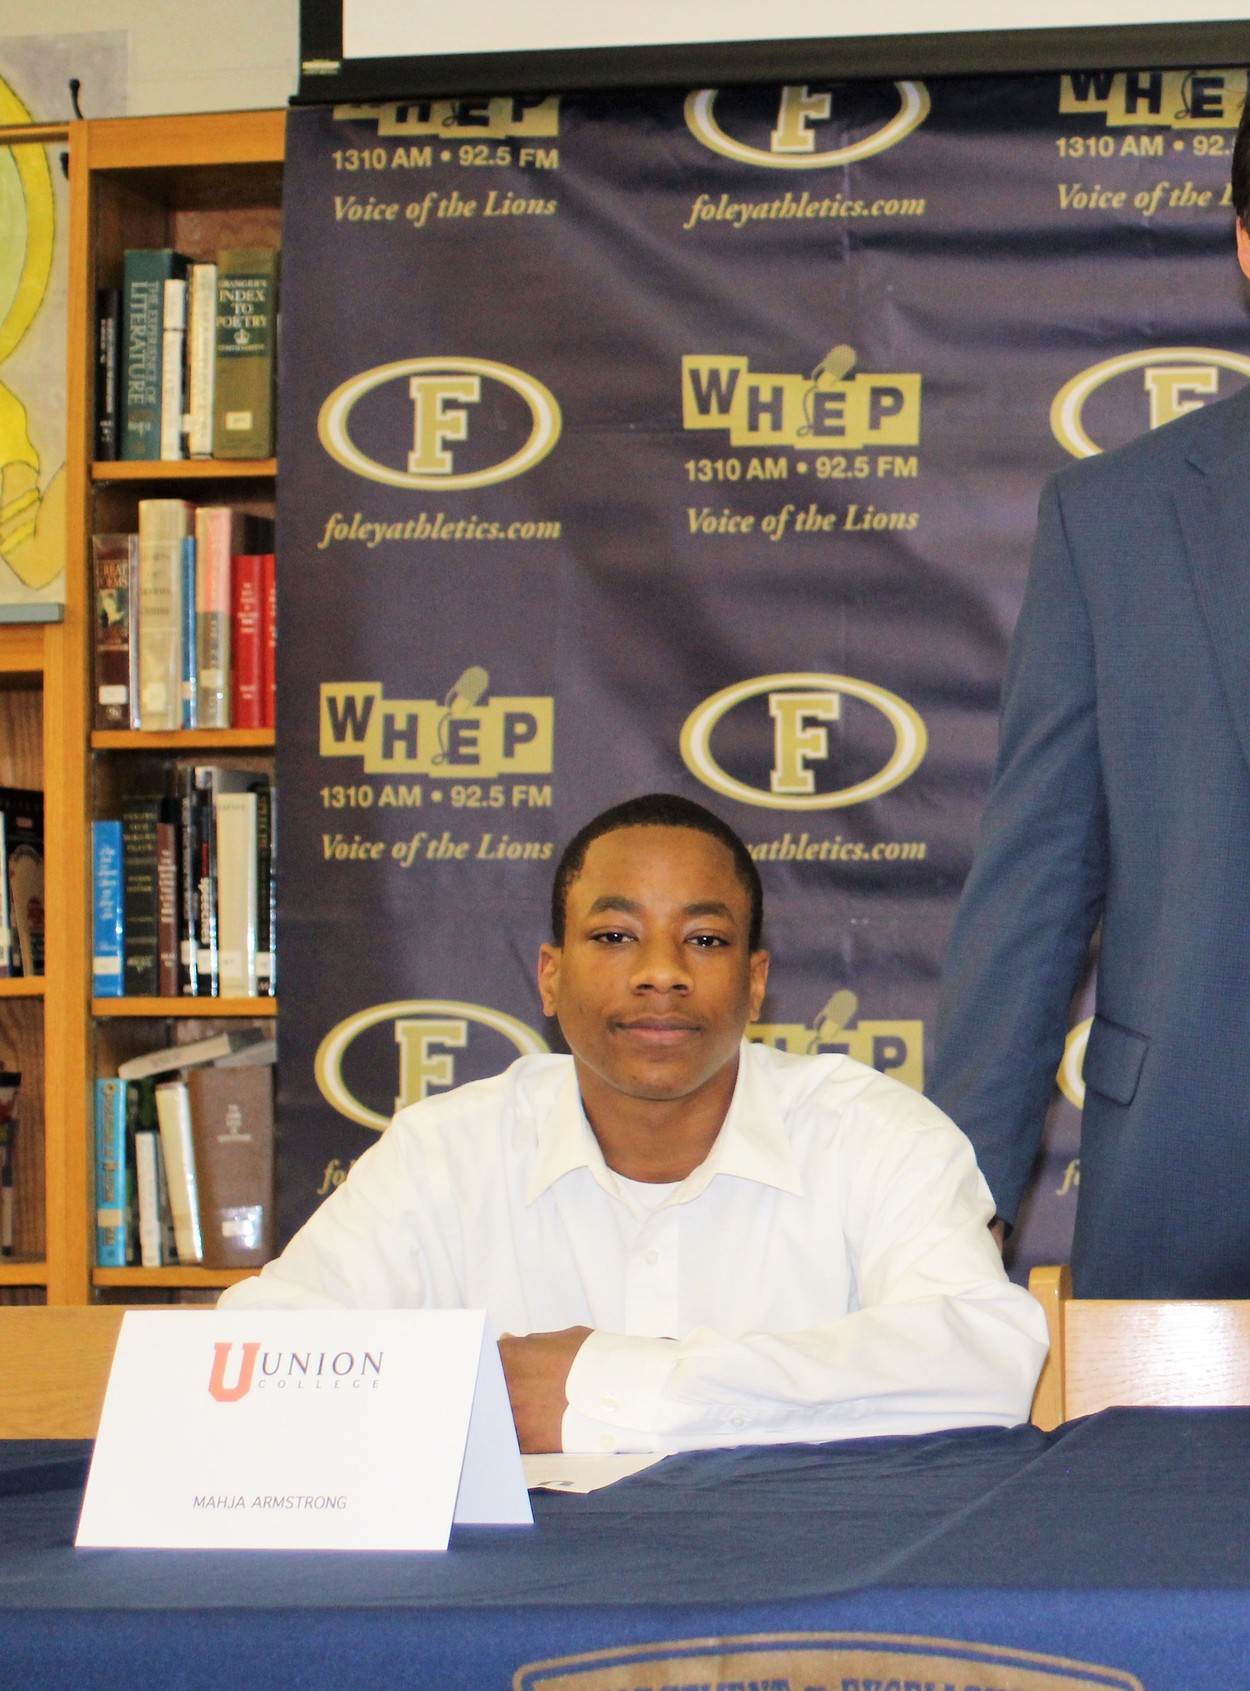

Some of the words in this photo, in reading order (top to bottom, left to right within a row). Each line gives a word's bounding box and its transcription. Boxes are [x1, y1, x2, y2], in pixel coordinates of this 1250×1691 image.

[769, 84, 832, 154] F
[334, 148, 387, 170] 1310
[392, 147, 432, 166] AM
[459, 145, 511, 165] 92.5
[520, 148, 558, 168] FM
[1057, 136, 1115, 157] 1310
[1121, 135, 1163, 155] AM
[1193, 135, 1234, 155] 92.
[335, 196, 400, 220] Voice
[406, 193, 440, 227] of
[437, 191, 476, 218] the
[484, 191, 556, 216] Lions
[683, 193, 926, 229] foleyathletics.com
[1059, 184, 1127, 208] Voice
[1133, 181, 1171, 215] of
[1166, 182, 1212, 206] the
[219, 290, 266, 301] INDEX
[231, 302, 252, 314] TO
[216, 315, 268, 328] POETRY
[128, 281, 149, 404] LITERATURE
[689, 368, 904, 436] WHEP
[407, 375, 482, 476] F
[685, 459, 741, 481] 1310
[747, 458, 787, 479] AM
[816, 456, 869, 478] 92.5
[878, 456, 918, 476] FM
[316, 513, 560, 549] foleyathletics.com
[688, 508, 754, 533] Voice
[761, 505, 801, 540] of
[796, 504, 836, 531] the
[844, 504, 918, 530] Lions
[326, 696, 537, 765] WHEP
[768, 690, 841, 794] F
[321, 786, 373, 808] 1310
[378, 785, 421, 806] AM
[451, 785, 505, 807] 92.5
[512, 786, 551, 806] FM
[323, 834, 384, 859] Voice
[391, 832, 430, 866] of
[421, 832, 469, 859] the
[477, 834, 554, 859] Lions
[749, 833, 926, 862] athletics.com
[394, 1017, 469, 1105] F
[208, 1342, 261, 1402] U
[261, 1351, 384, 1376] UNION
[258, 1379, 380, 1390] COLLEGE
[193, 1496, 246, 1510] MAHJA
[251, 1496, 348, 1510] ARMSTRONG
